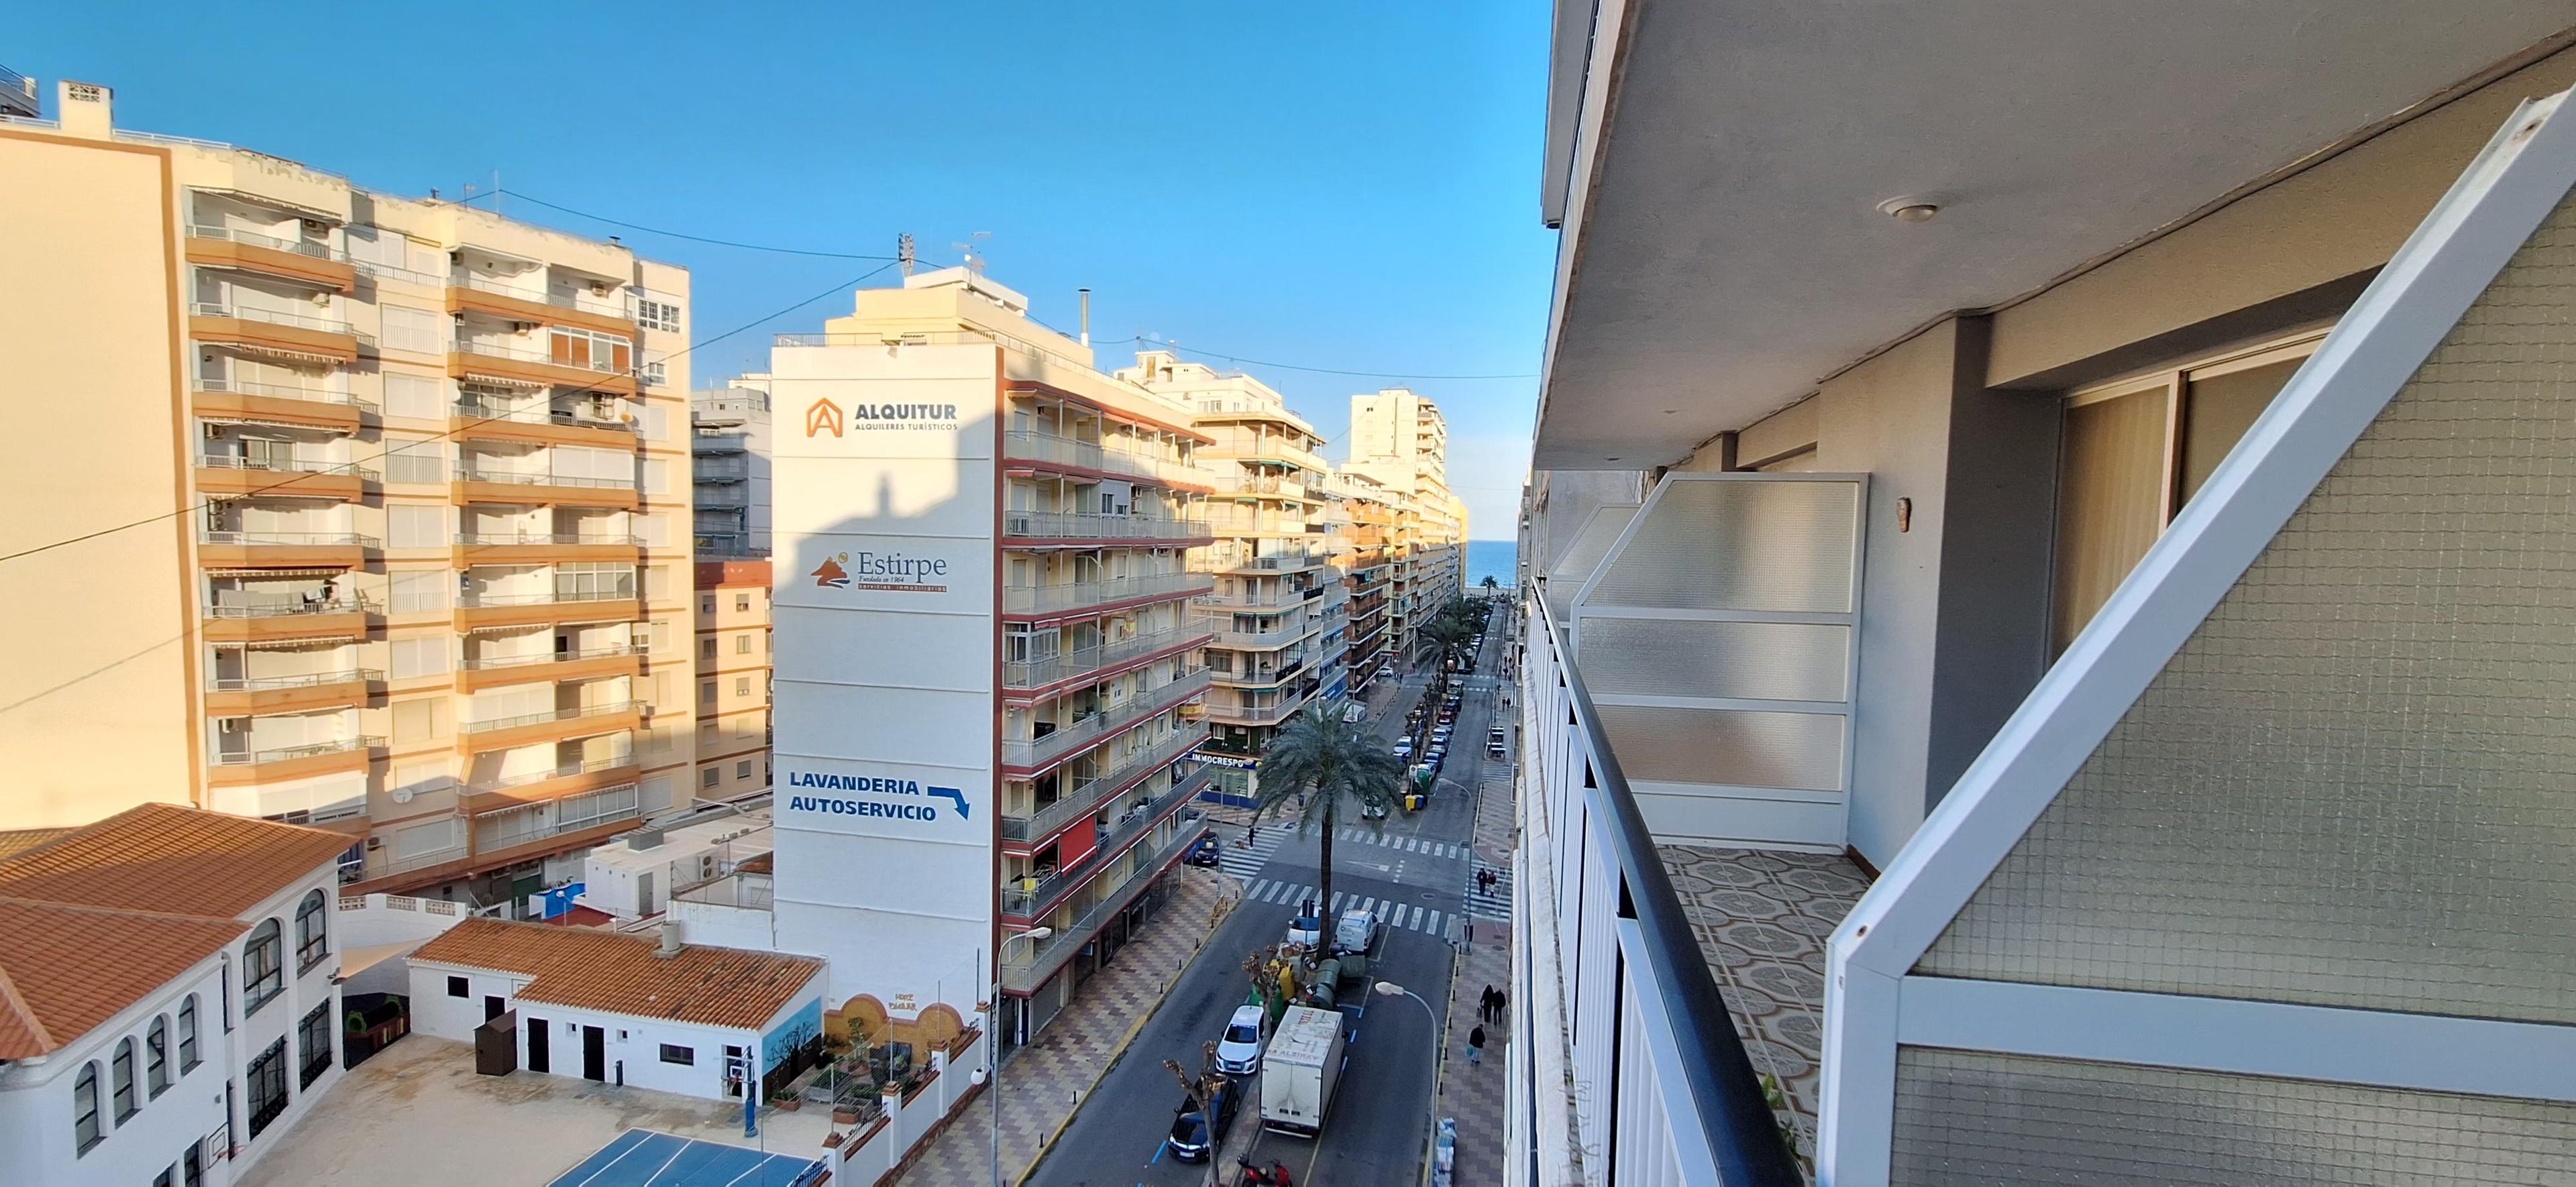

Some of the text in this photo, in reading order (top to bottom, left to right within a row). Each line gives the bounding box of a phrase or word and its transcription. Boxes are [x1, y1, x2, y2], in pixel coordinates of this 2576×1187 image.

[855, 404, 957, 420] ALQUITUR
[908, 422, 958, 431] TURÍSTICOS
[857, 552, 947, 584] Estirpe
[1192, 753, 1244, 767] INMOCRESPO
[790, 772, 920, 795] LAVANDERIA
[790, 796, 936, 822] AUTOSERVICIO
